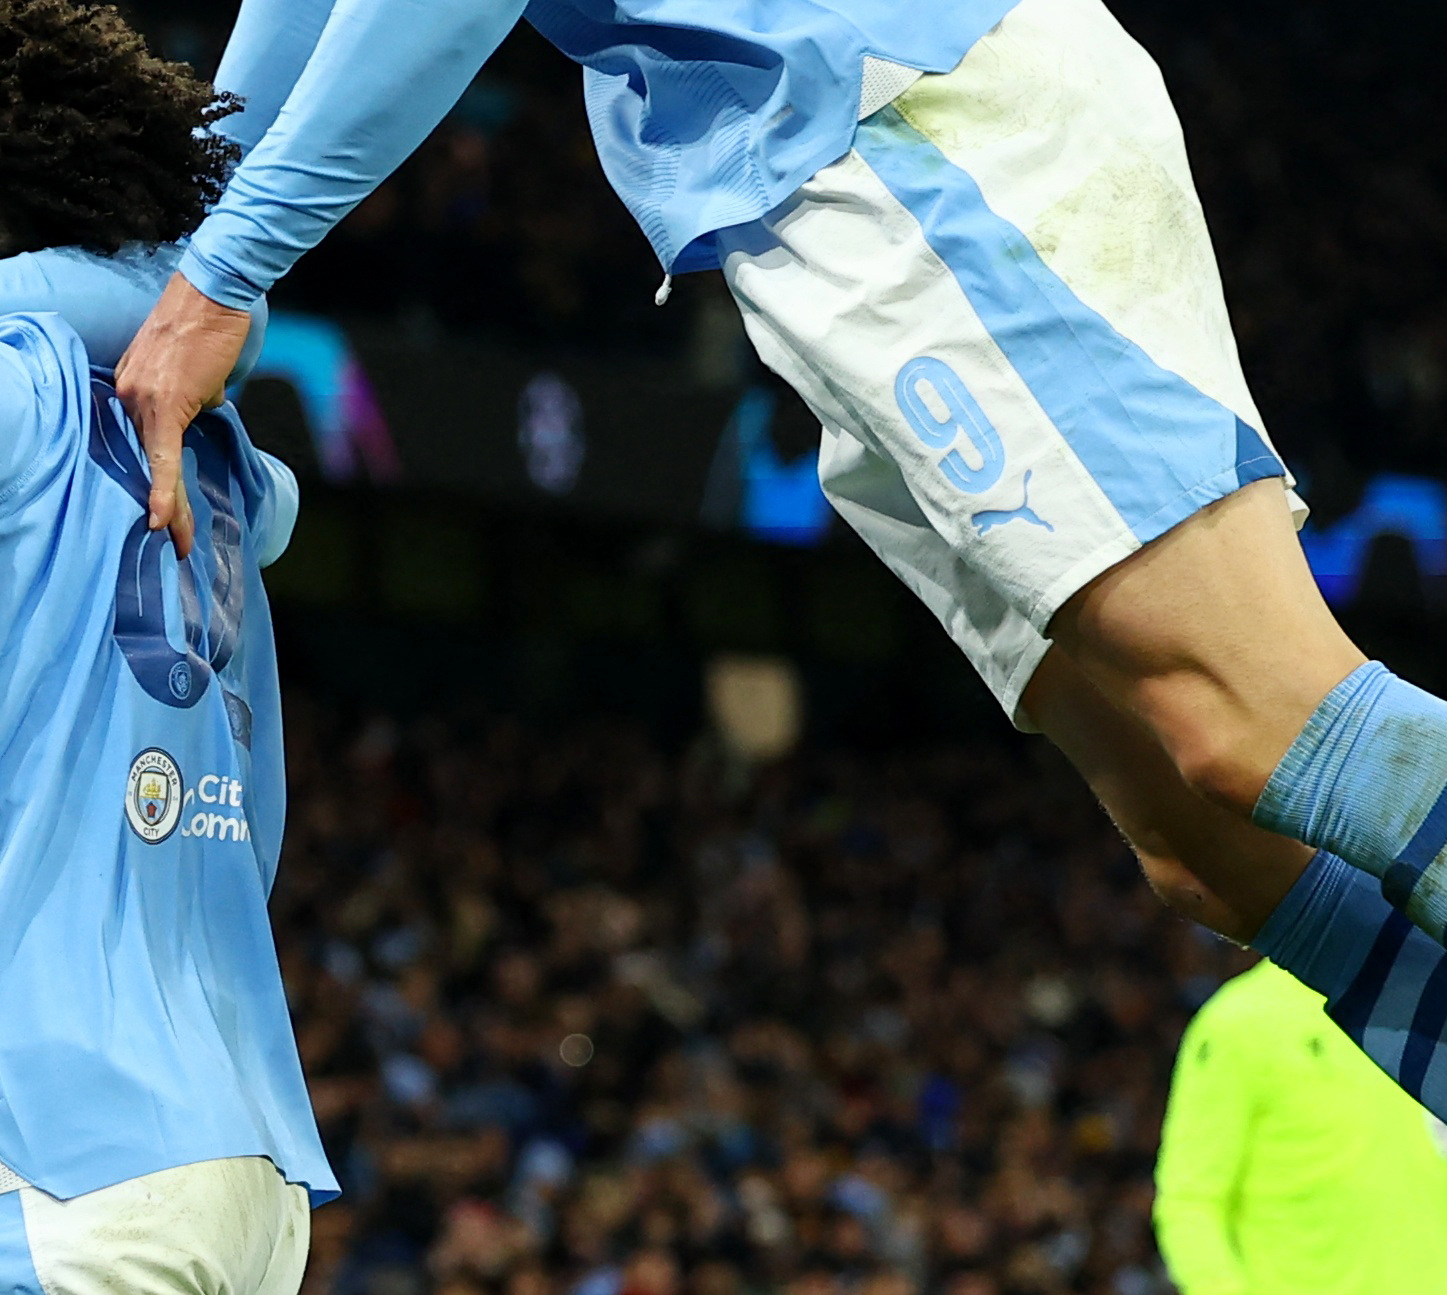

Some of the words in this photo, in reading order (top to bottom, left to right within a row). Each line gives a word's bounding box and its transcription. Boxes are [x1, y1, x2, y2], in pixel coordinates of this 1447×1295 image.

[894, 356, 1005, 495] 9
[131, 755, 178, 786] MANCHESTER
[198, 774, 243, 807] Cit
[143, 827, 160, 837] CITY
